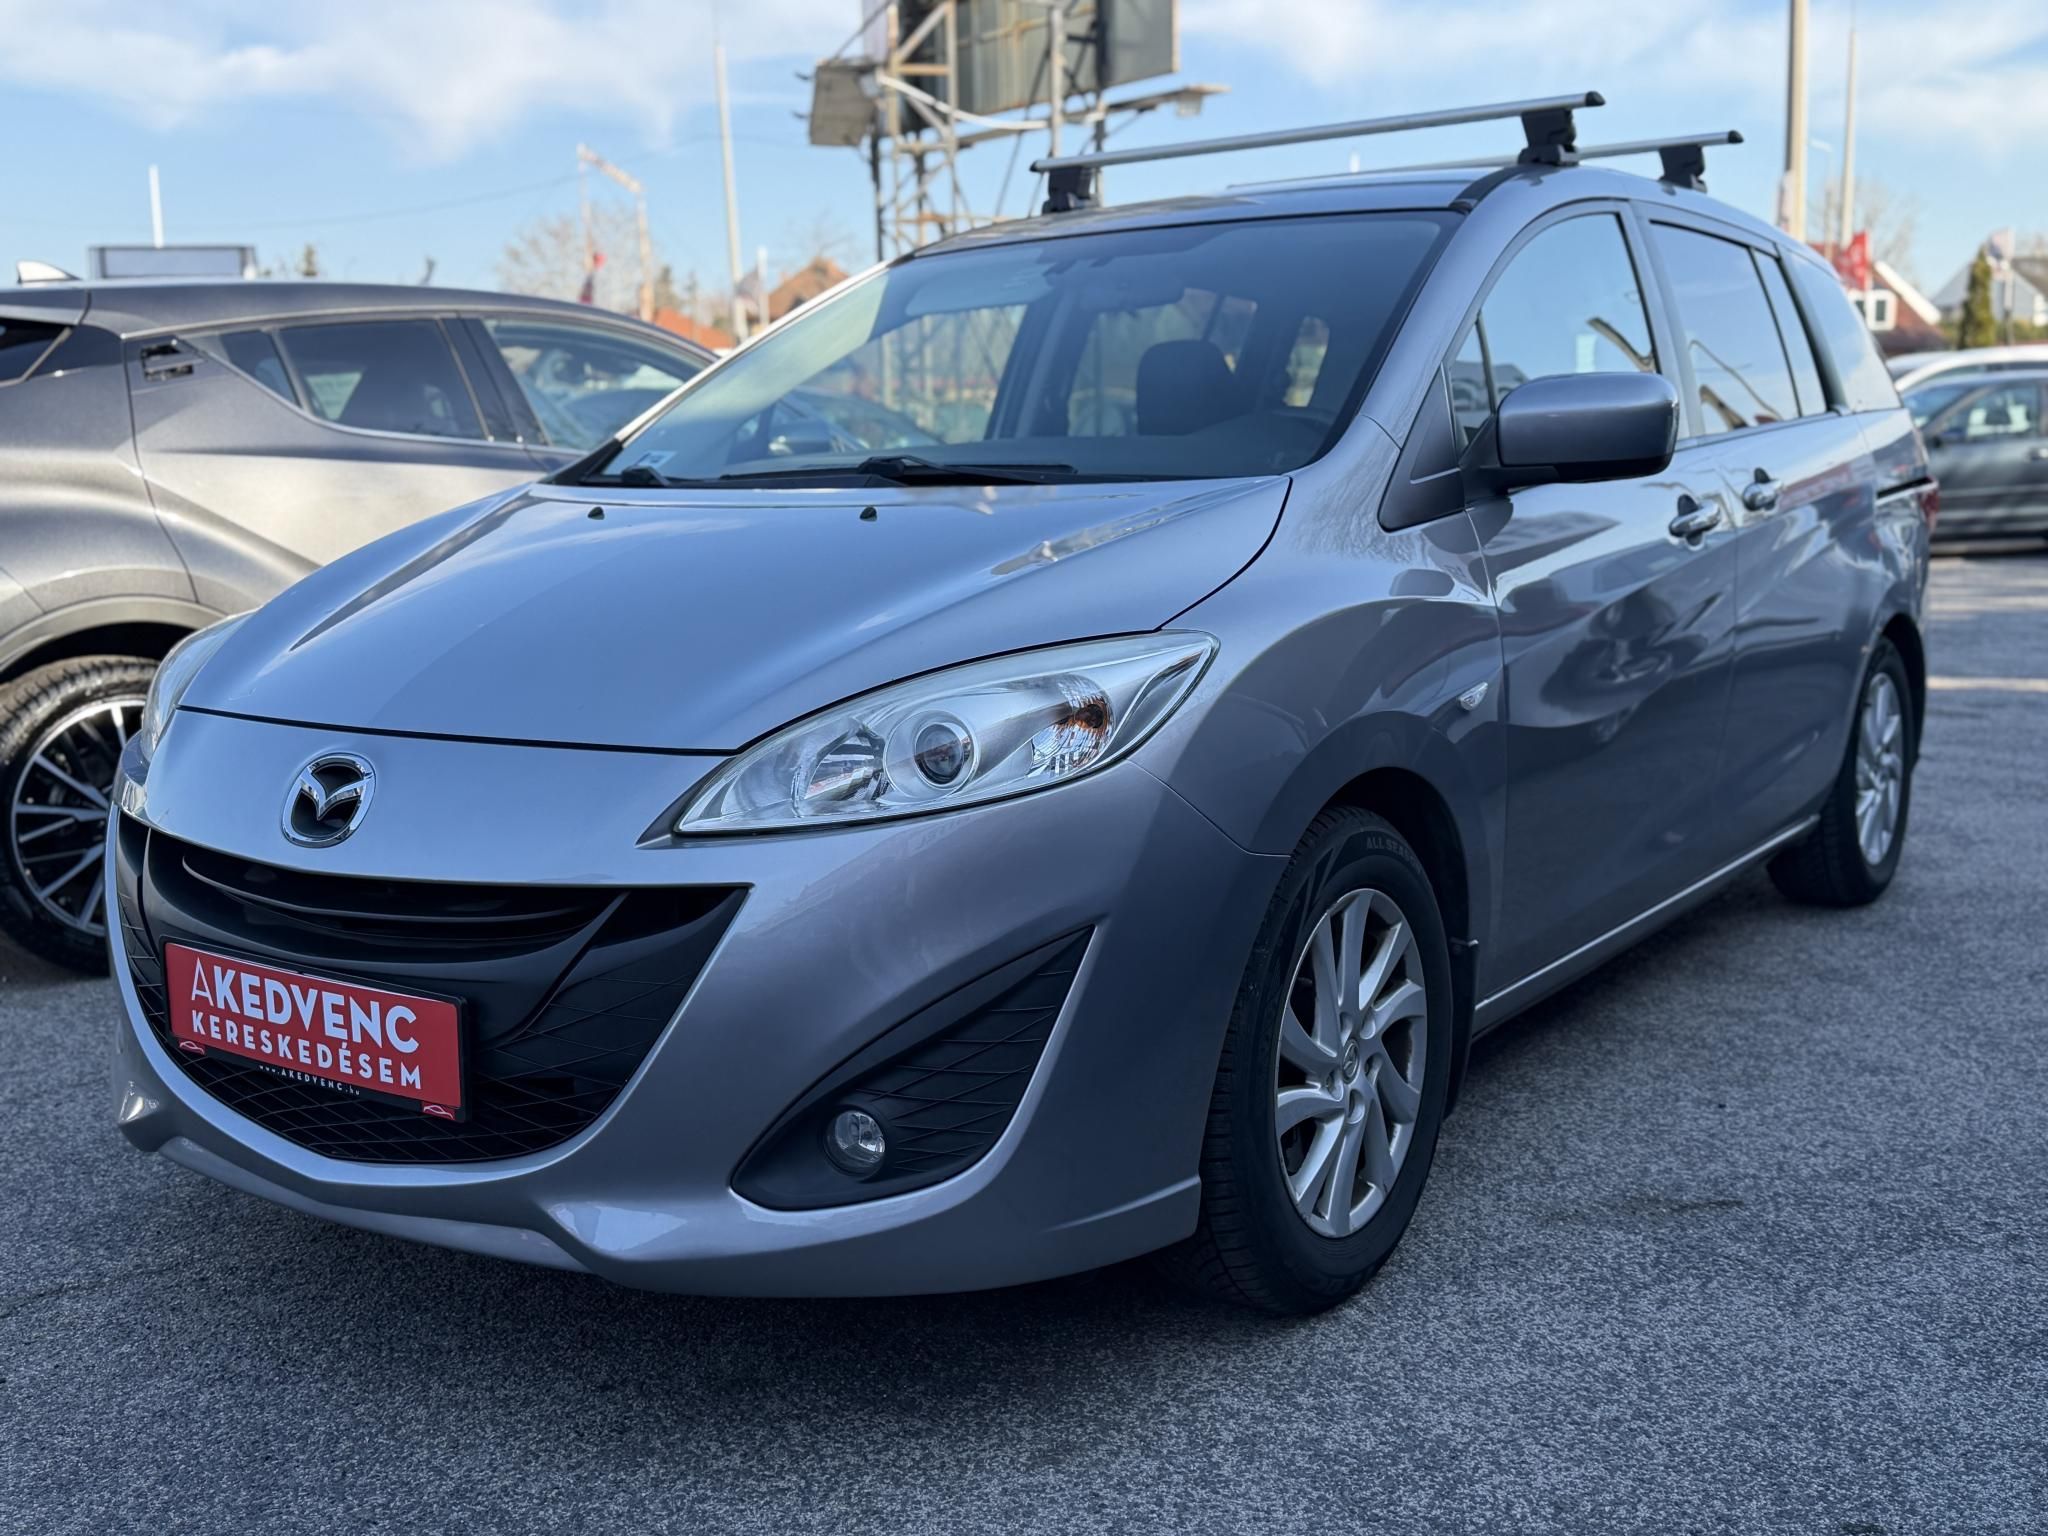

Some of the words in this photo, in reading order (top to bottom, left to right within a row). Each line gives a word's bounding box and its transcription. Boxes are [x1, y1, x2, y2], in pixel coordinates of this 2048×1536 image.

[1366, 836, 1385, 850] ALL
[191, 956, 420, 1053] AKEDVENC
[191, 1010, 422, 1090] KERESKEDÉSEM
[258, 1064, 361, 1096] www.AKEDVENC.hu
